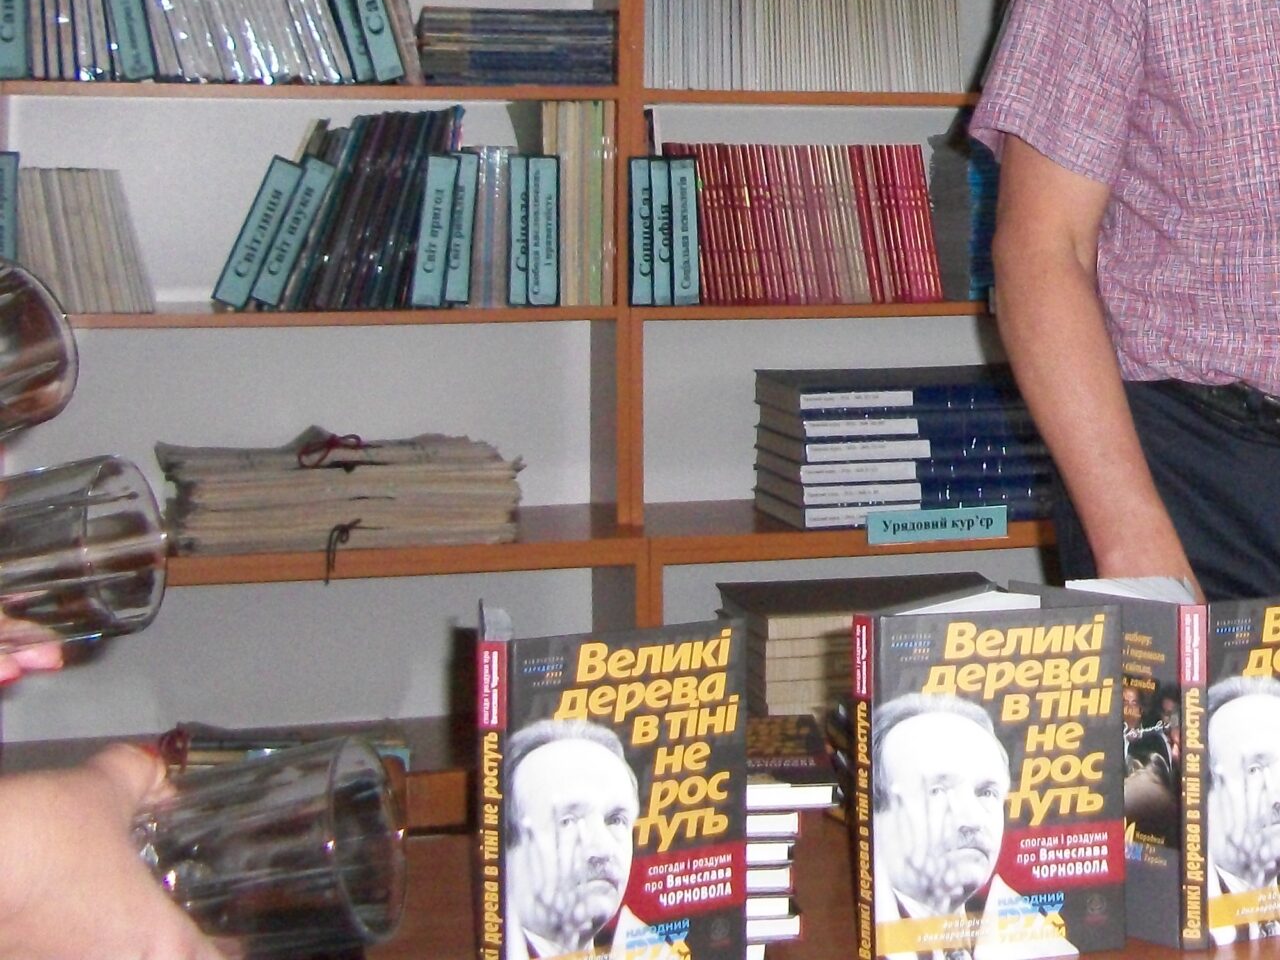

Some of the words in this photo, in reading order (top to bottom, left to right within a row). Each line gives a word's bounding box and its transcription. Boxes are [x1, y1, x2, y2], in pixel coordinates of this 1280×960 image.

[268, 239, 290, 276] Світ
[289, 186, 315, 237] науки
[430, 188, 445, 239] пригод
[422, 242, 439, 274] Світ
[680, 235, 691, 290] Соціальна
[883, 517, 947, 535] Урядовий
[576, 628, 732, 682] Великі
[944, 614, 1105, 659] Великі
[553, 672, 727, 725] дерева
[921, 656, 1100, 700] дерева
[632, 714, 659, 744] в
[665, 694, 740, 740] тіні
[1002, 693, 1029, 721] в
[1036, 678, 1114, 719] тіні
[1184, 687, 1204, 746] ростуть
[857, 701, 871, 765] ростуть
[1026, 721, 1084, 752] не
[484, 731, 502, 799] ростуть
[654, 741, 711, 775] не
[858, 768, 869, 788] не
[1021, 751, 1105, 795] рос
[1186, 753, 1201, 772] не
[650, 771, 730, 820] рос
[856, 791, 869, 821] тіні
[1006, 785, 1104, 826] туть
[1182, 776, 1201, 806] тіні
[484, 803, 499, 824] не
[633, 807, 729, 852] туть
[860, 826, 870, 836] в
[1188, 810, 1201, 820] в
[480, 829, 499, 860] тіні
[1017, 852, 1036, 864] про
[1039, 845, 1108, 862] Вячеслава
[1020, 836, 1058, 849] спогади
[1067, 832, 1108, 847] роздуми
[1187, 826, 1205, 879] дерева
[484, 865, 499, 876] в
[645, 879, 663, 893] про
[666, 867, 732, 889] Вячеслава
[648, 862, 685, 875] спогади
[692, 854, 732, 871] роздуми
[859, 843, 873, 900] дерева
[1032, 860, 1109, 879] ЧОРНОВОЛА
[484, 882, 502, 945] дерева
[659, 882, 732, 907] ЧОРНОВОЛА
[1183, 885, 1201, 939] Великі
[858, 903, 871, 959] Великі
